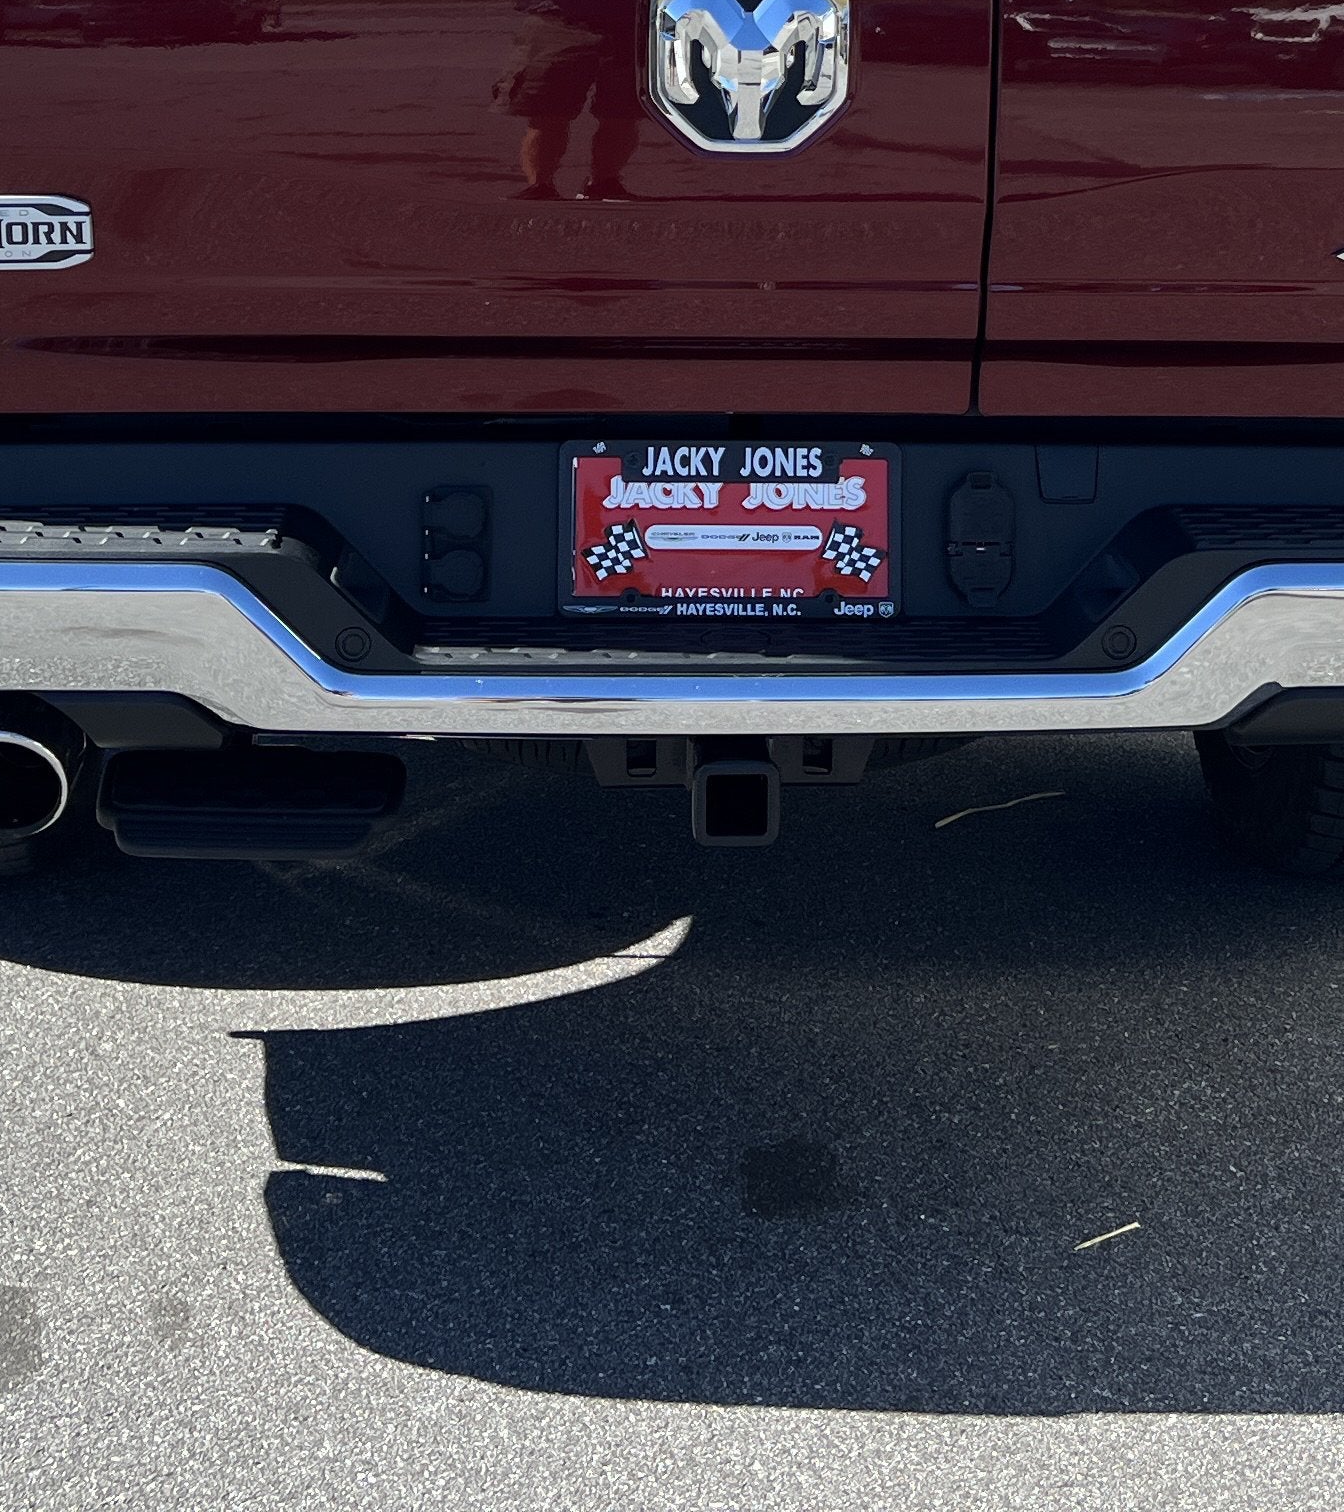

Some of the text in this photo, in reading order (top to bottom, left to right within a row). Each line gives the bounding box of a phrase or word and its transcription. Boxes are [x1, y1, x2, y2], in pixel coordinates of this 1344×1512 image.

[642, 446, 823, 477] JACKY JONES
[602, 475, 867, 510] JACKY JONES
[751, 531, 780, 544] Jeep
[676, 603, 769, 617] HAYESVILLE,
[772, 604, 802, 616] N.C.
[833, 601, 874, 618] Jeep
